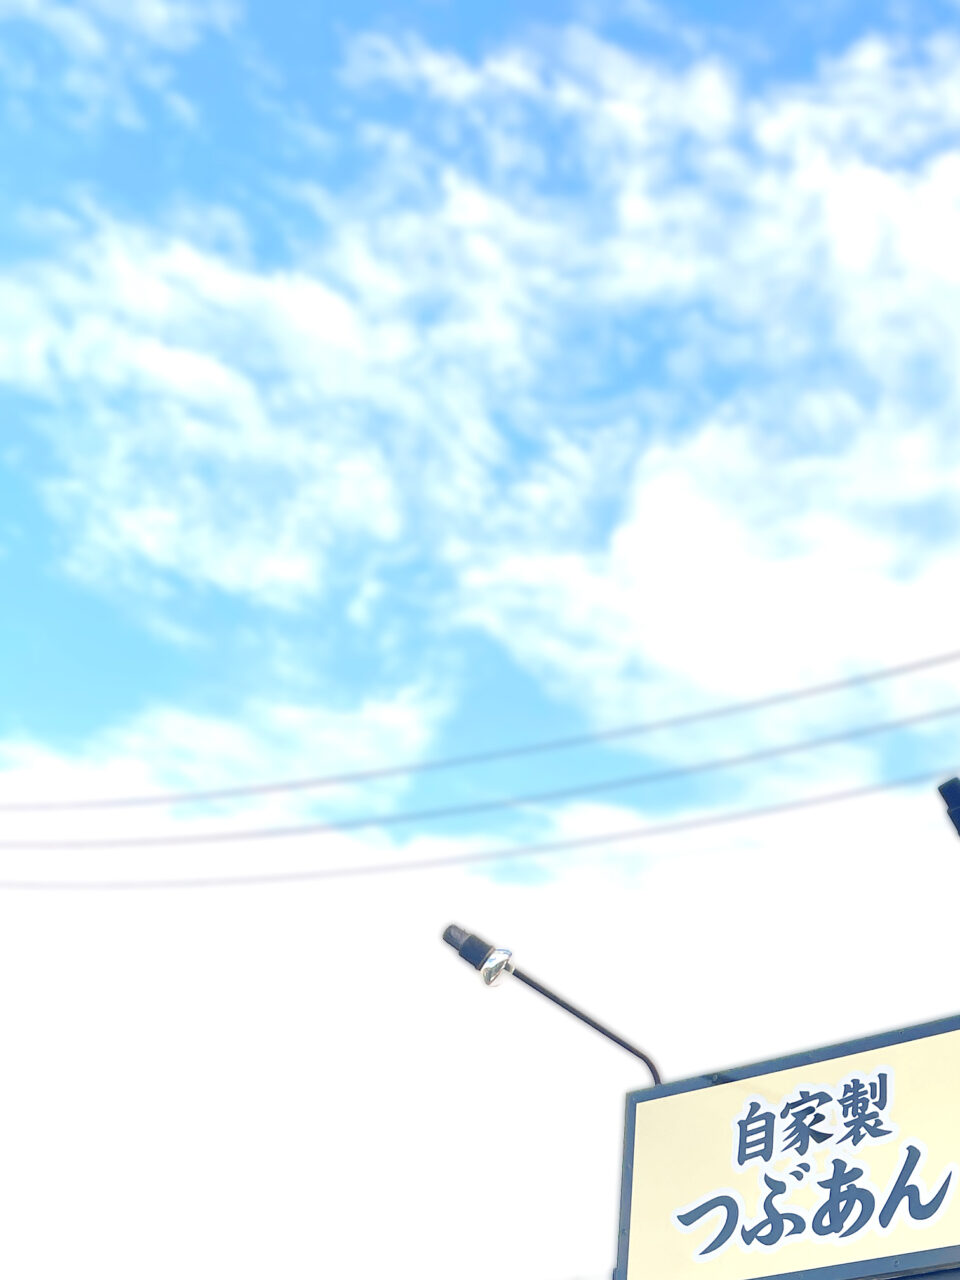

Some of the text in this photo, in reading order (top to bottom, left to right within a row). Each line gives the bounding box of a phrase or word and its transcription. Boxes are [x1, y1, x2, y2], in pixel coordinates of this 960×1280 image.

[737, 1073, 893, 1166] 自家製
[676, 1144, 953, 1256] つぶあん
